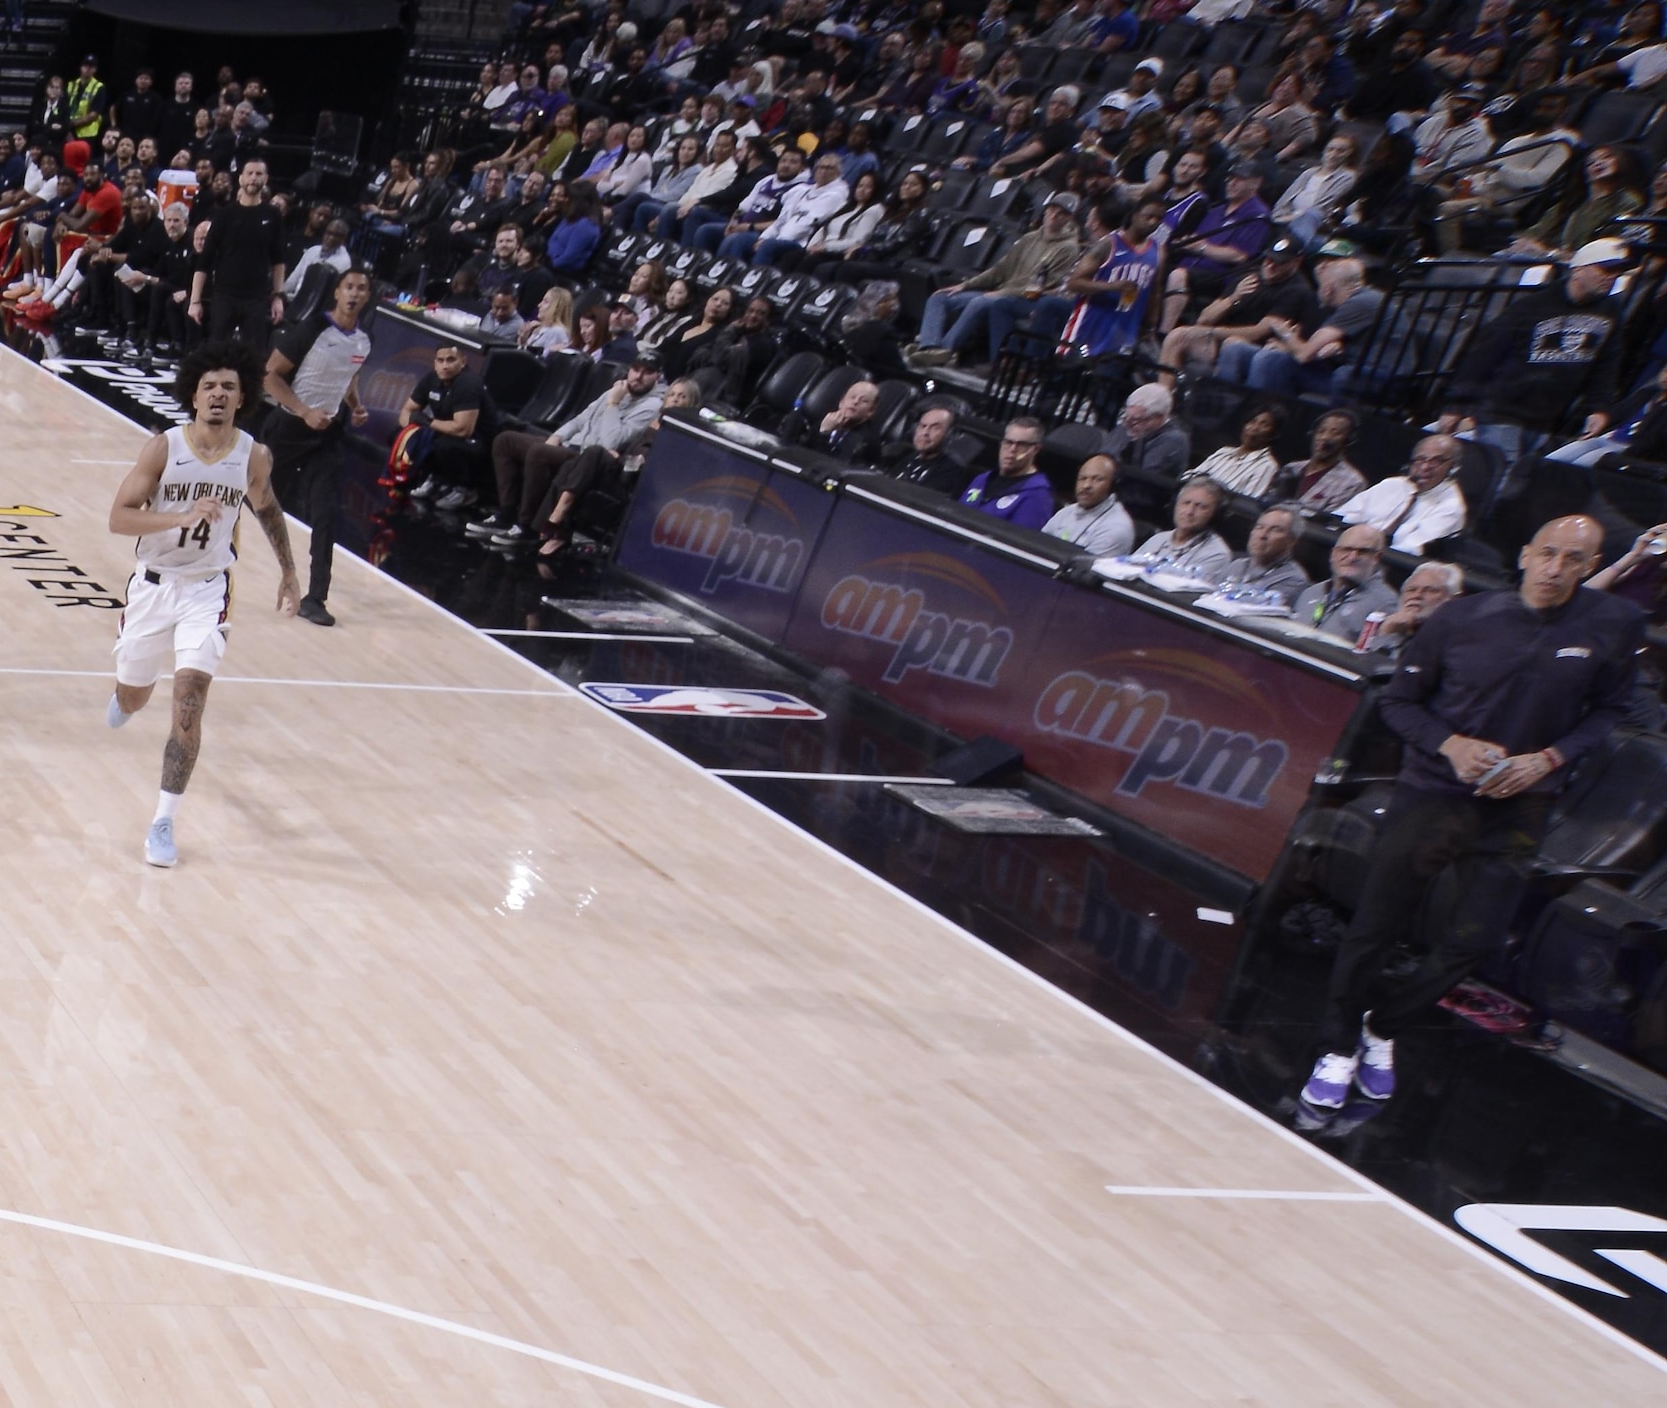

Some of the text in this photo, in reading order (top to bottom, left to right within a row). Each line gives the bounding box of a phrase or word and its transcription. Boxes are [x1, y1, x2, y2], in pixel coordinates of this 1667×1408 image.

[163, 482, 191, 502] NEW
[177, 518, 212, 550] 14
[651, 498, 805, 595] ampm
[821, 575, 1014, 688] ampm
[1033, 670, 1290, 809] ampm
